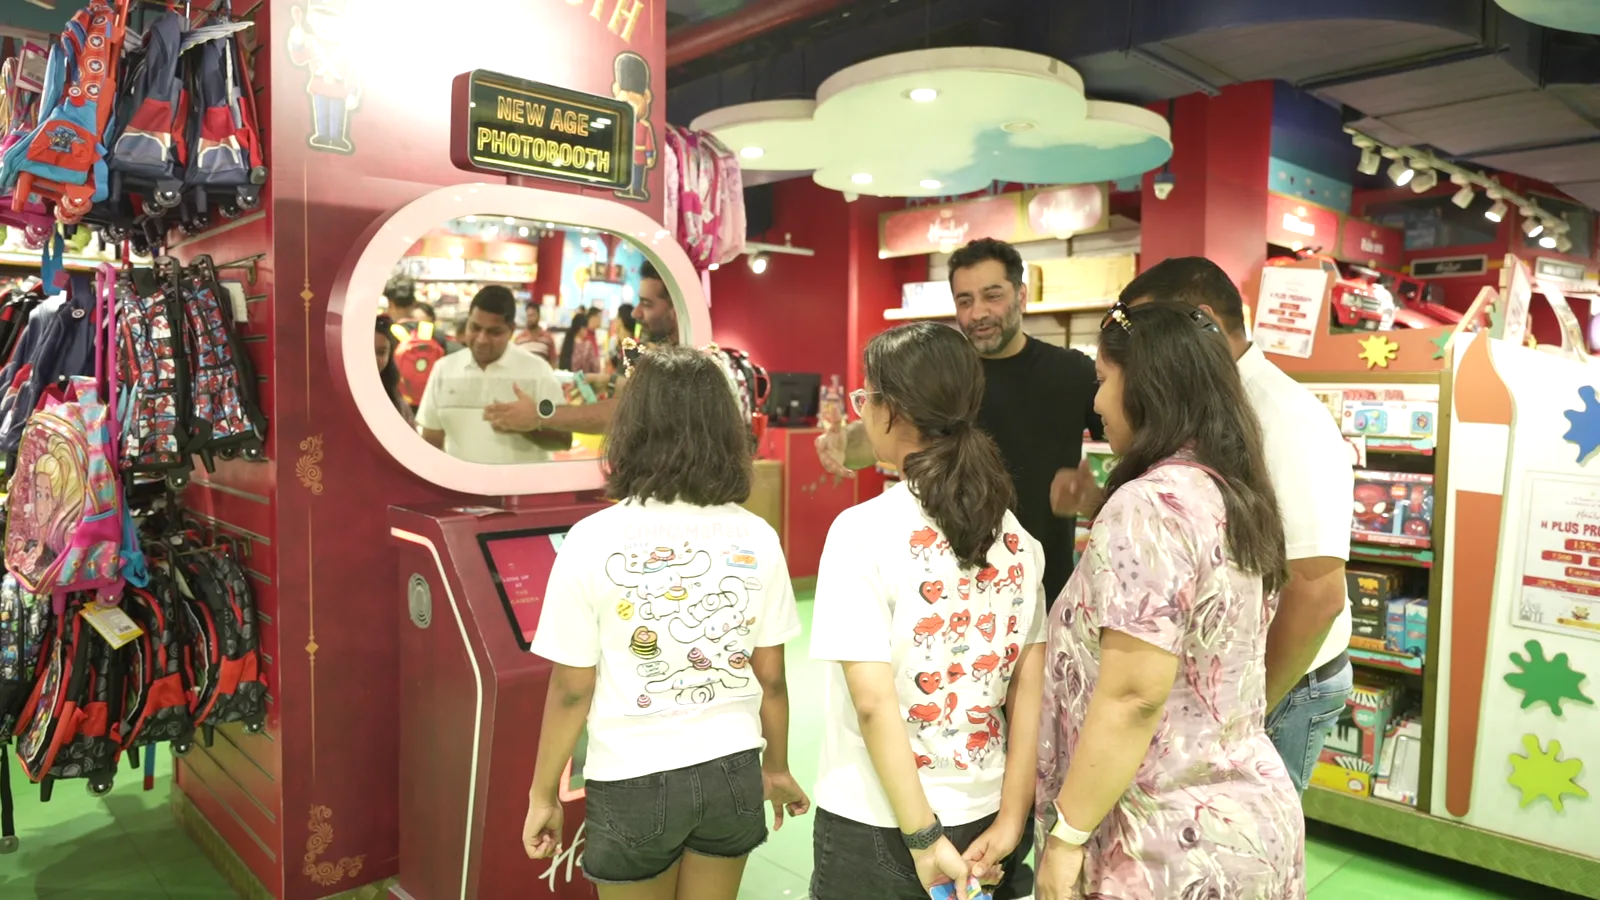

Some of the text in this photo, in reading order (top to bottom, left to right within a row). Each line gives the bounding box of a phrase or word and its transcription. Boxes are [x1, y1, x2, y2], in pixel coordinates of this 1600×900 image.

[496, 95, 589, 137] NEW AGE
[477, 126, 610, 174] PHOTOBOOTH
[1552, 521, 1579, 534] PLUS
